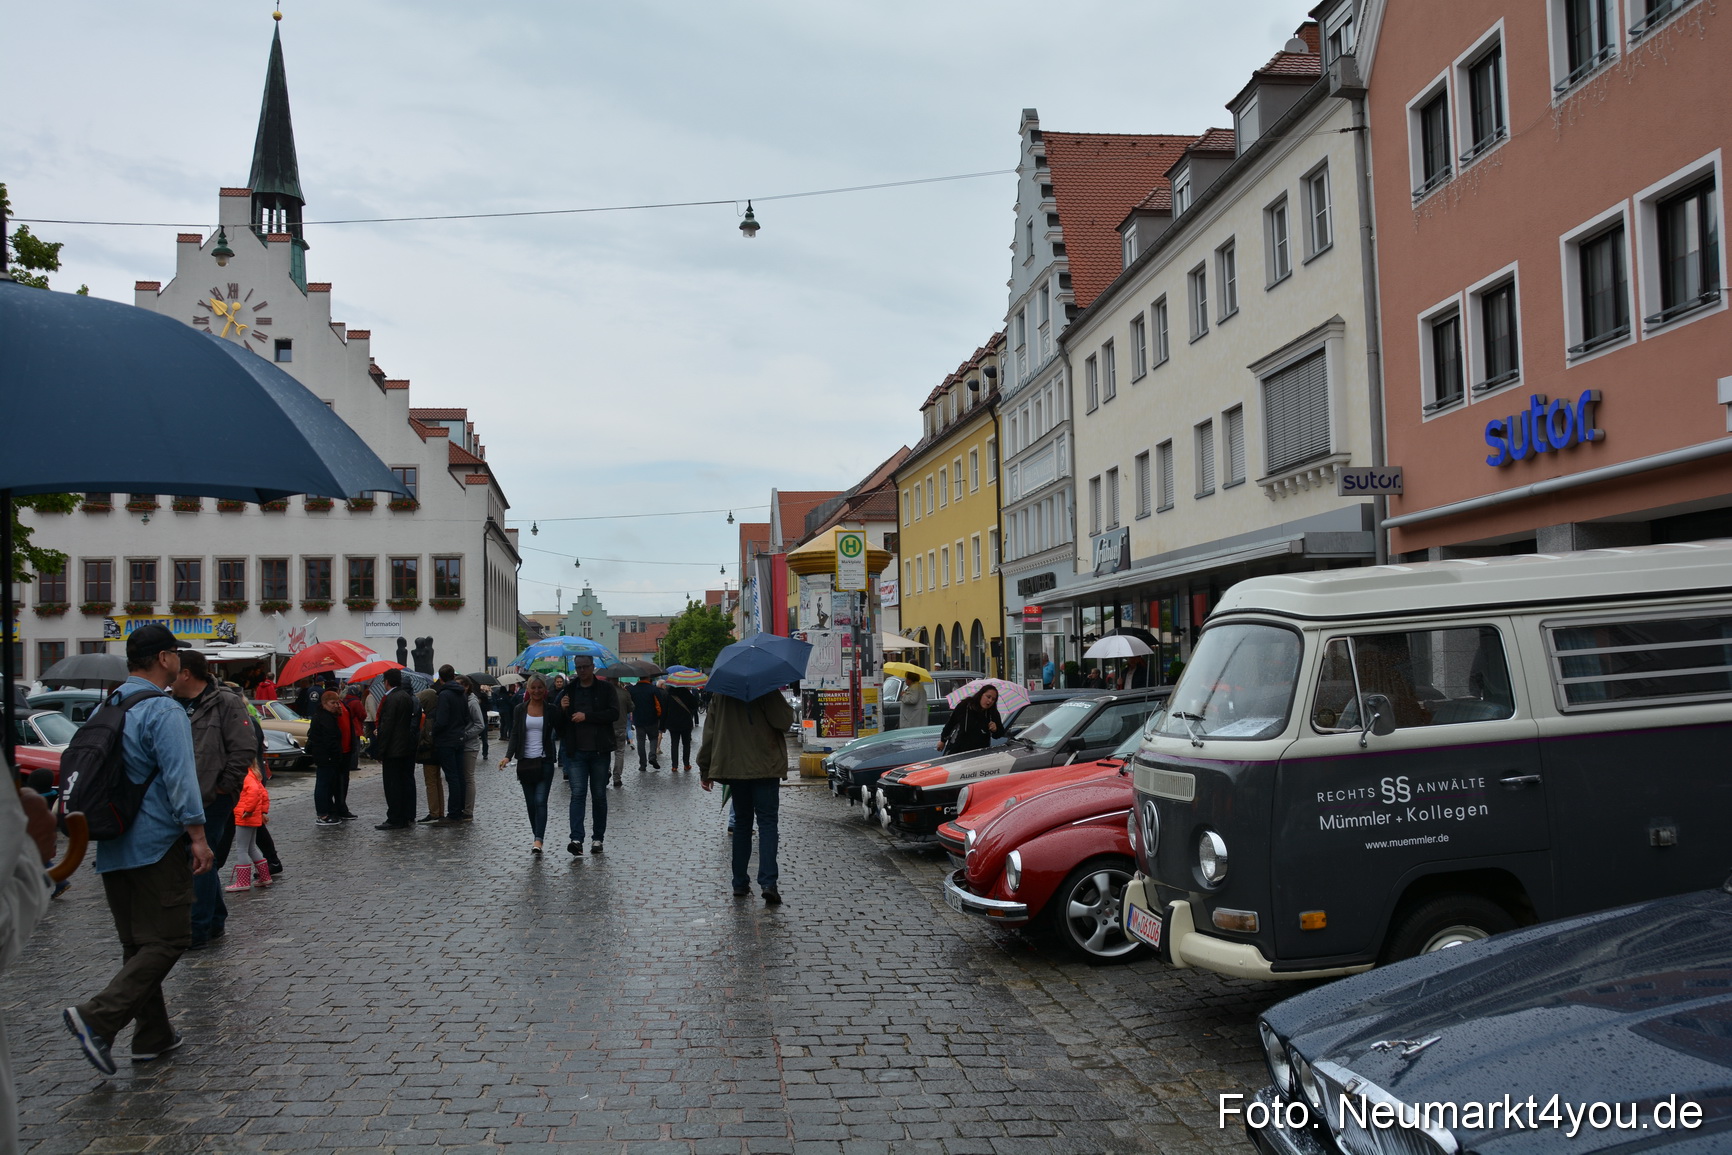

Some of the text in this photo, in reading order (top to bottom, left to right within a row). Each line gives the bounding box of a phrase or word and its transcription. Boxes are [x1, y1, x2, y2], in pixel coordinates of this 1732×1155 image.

[1343, 471, 1402, 491] sutor.
[845, 540, 857, 553] H
[979, 768, 1000, 777] Sport
[1317, 787, 1376, 802] RECHTS
[1416, 777, 1486, 793] ANWÄLTE
[1319, 811, 1391, 830] Mümmler
[1406, 804, 1489, 822] Kollegen
[1365, 834, 1450, 849] www.muemmler.de
